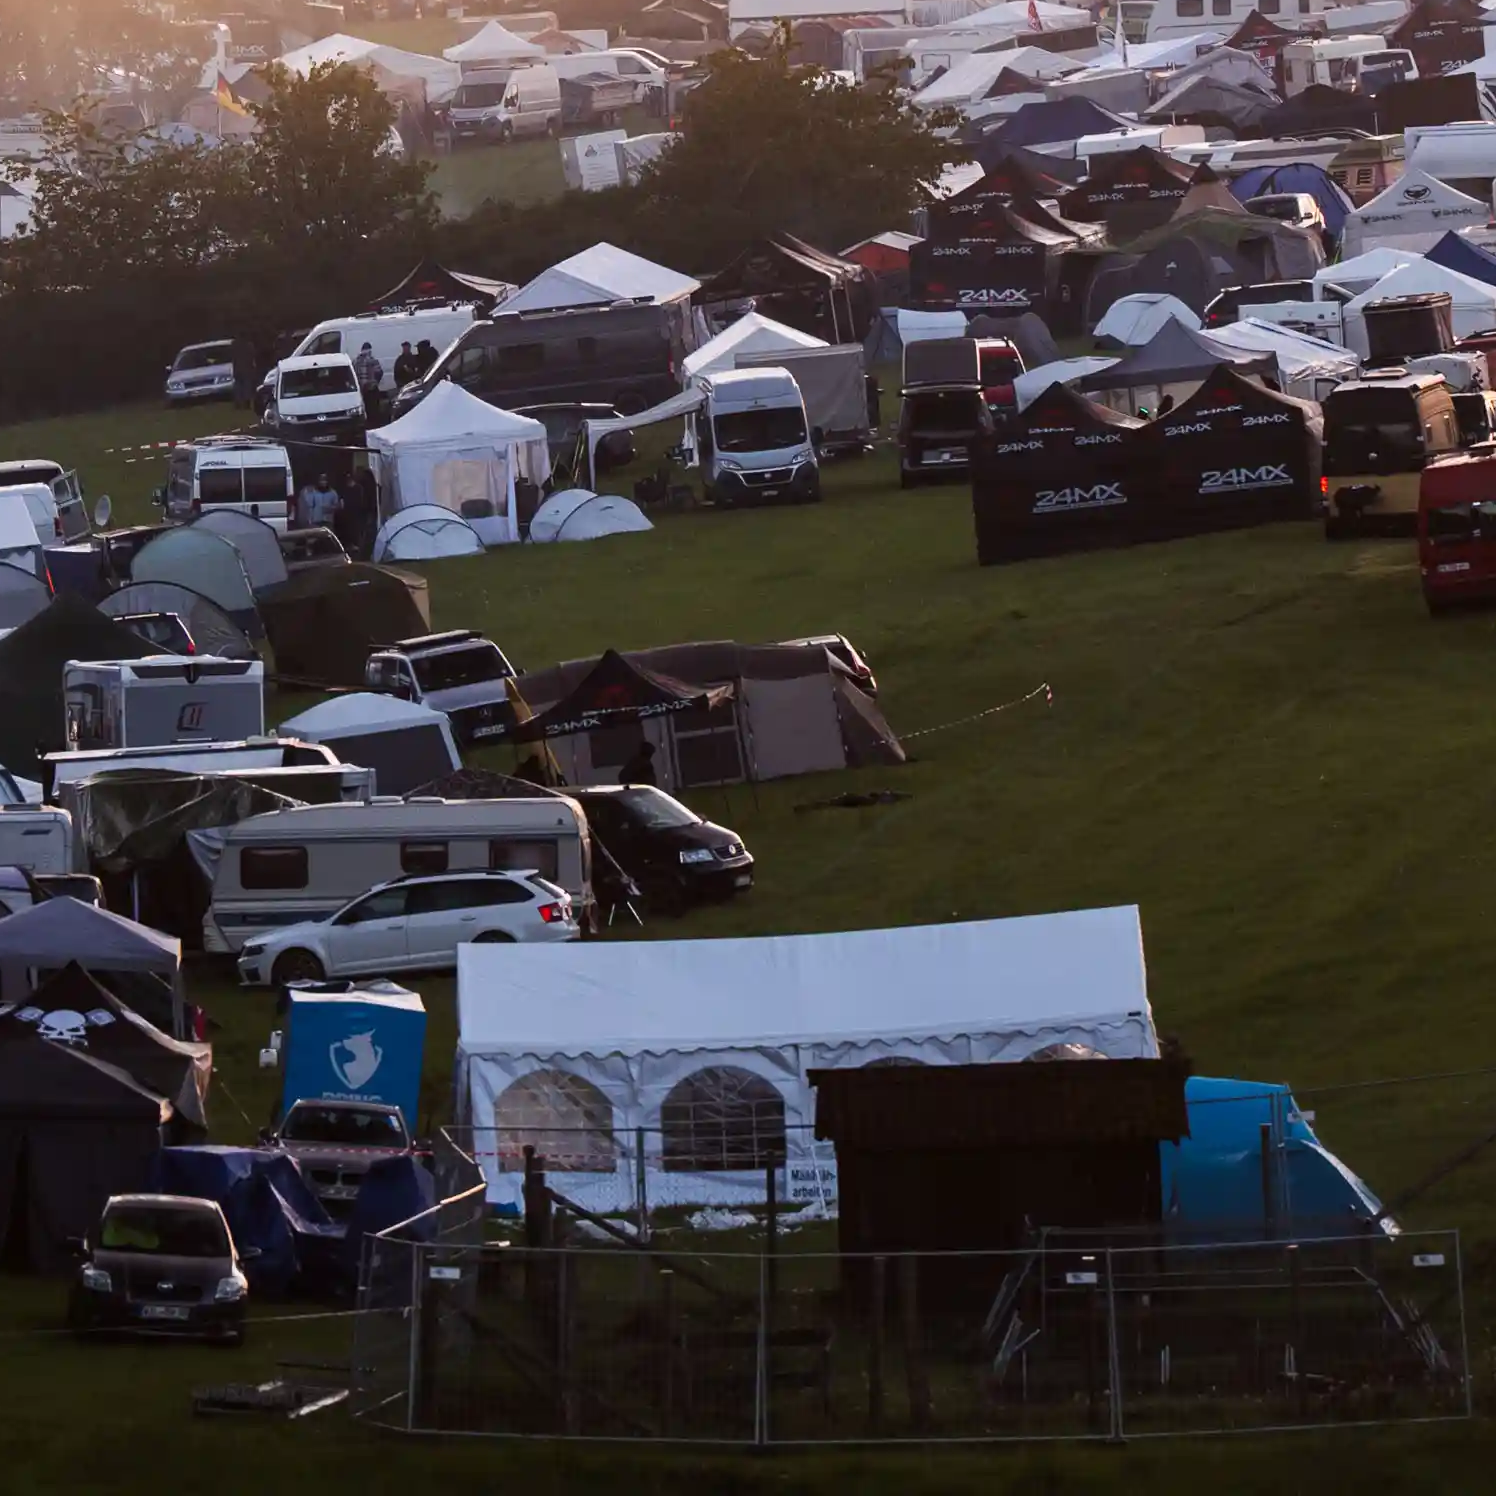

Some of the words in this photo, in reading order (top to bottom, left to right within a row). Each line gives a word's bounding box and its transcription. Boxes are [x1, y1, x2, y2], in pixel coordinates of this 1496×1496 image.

[959, 288, 1029, 302] 24MX
[1243, 413, 1290, 426] 24MX
[1164, 422, 1212, 436] 24MX
[1074, 433, 1122, 446] 24MX
[997, 440, 1044, 454] 24MX
[1201, 463, 1291, 487] 24MX
[1035, 482, 1124, 507] 24MX
[638, 699, 693, 717] 24MX
[545, 718, 601, 735] 24MX
